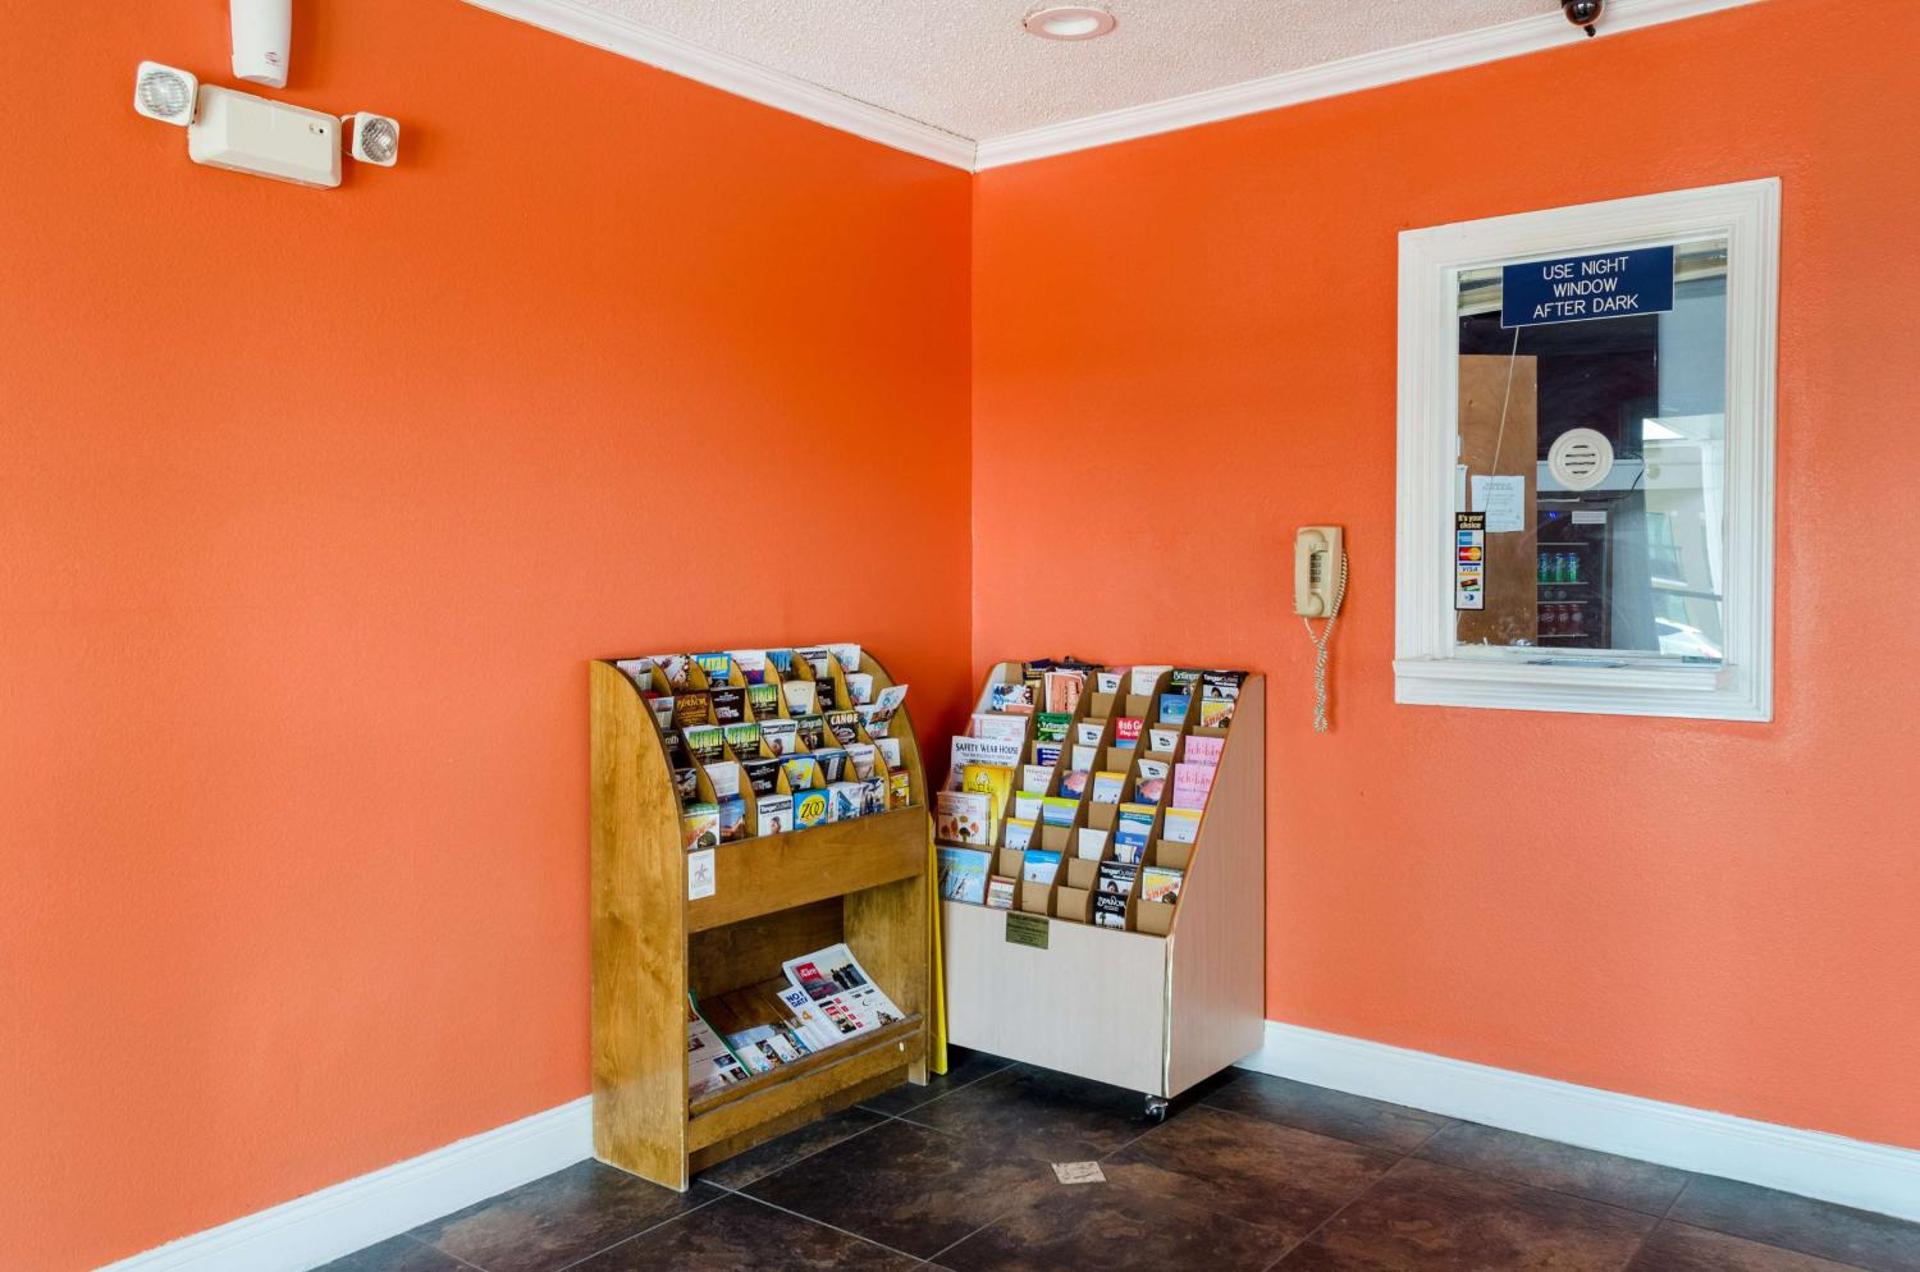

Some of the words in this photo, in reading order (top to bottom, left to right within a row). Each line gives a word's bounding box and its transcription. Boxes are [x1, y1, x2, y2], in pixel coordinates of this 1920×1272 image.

[1543, 263, 1575, 281] USE
[1581, 256, 1629, 275] NIGHT
[1553, 277, 1618, 298] WINDOW
[1532, 300, 1586, 319] AFTER
[1592, 293, 1639, 313] DARK
[830, 712, 859, 726] CANOE
